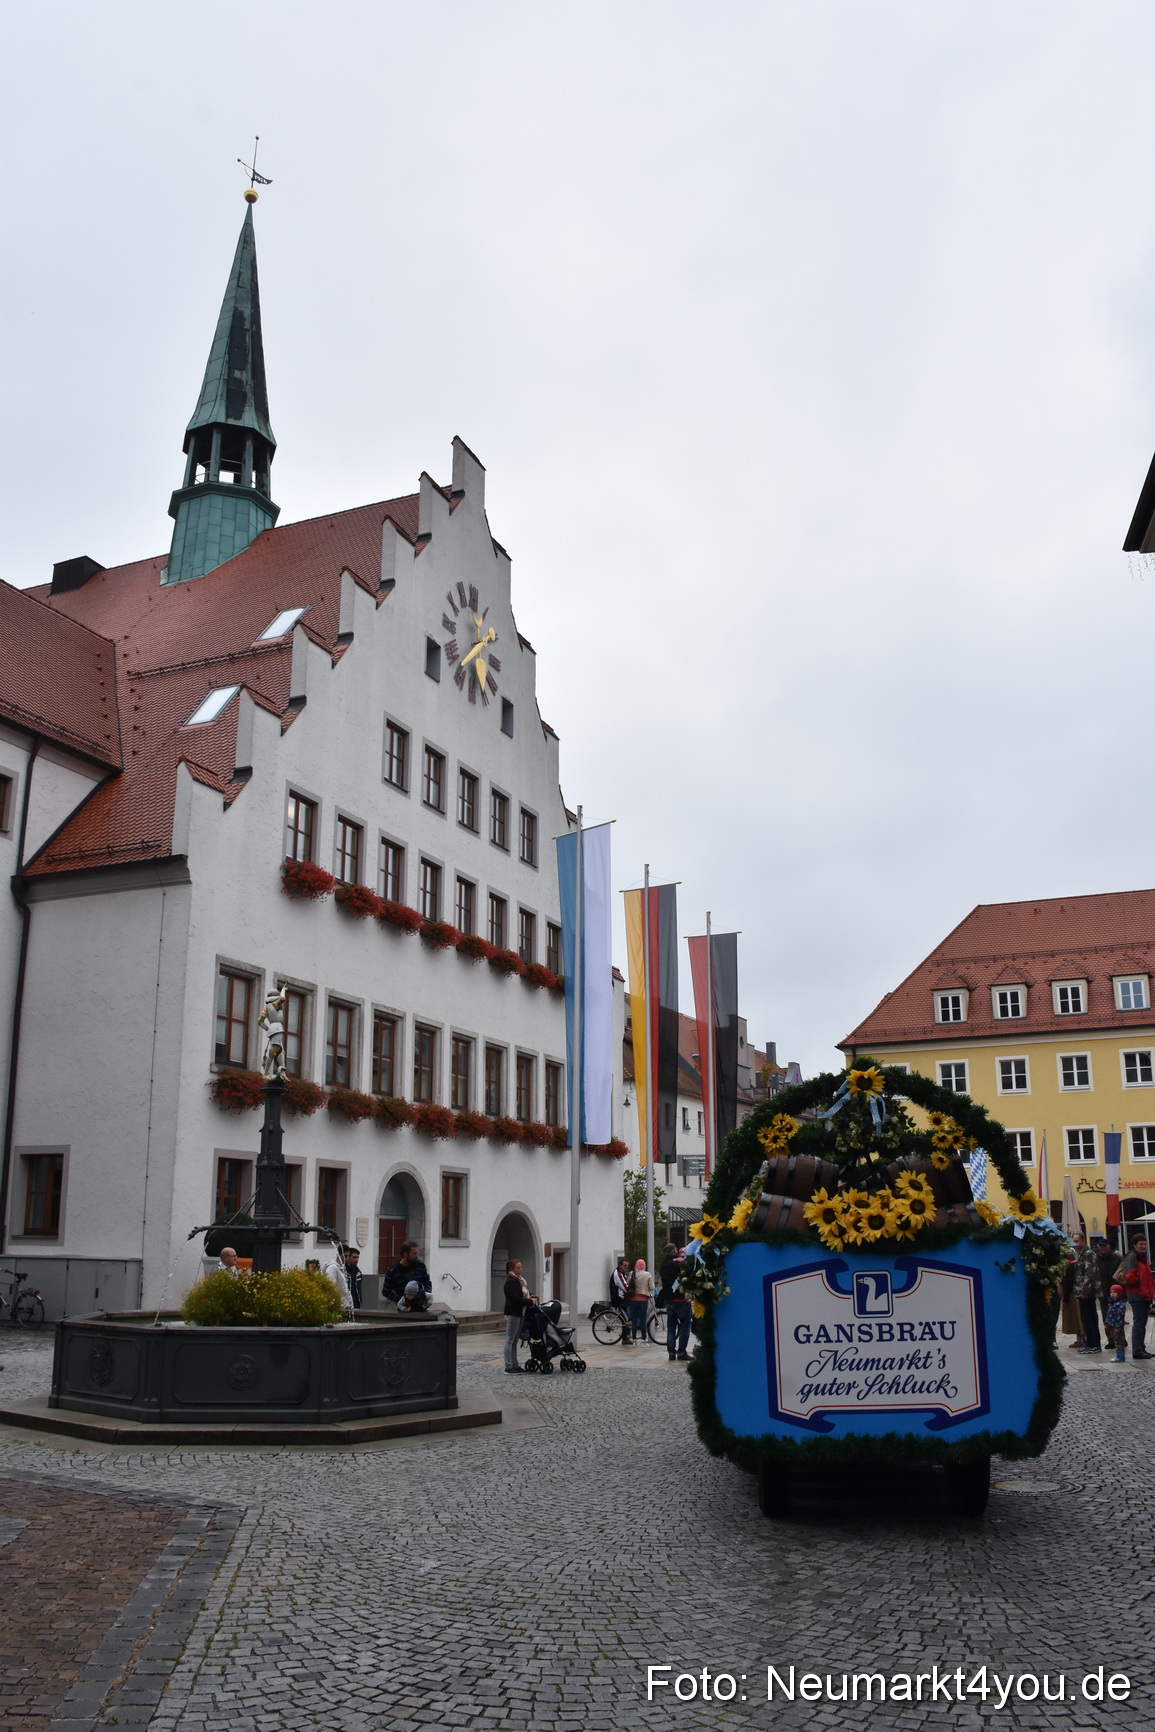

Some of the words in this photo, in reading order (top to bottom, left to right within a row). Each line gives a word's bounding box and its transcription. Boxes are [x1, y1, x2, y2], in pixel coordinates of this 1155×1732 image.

[793, 1321, 957, 1344] GANSBRÄU
[805, 1346, 947, 1378] Neumarkt's
[796, 1377, 859, 1404] guter
[856, 1373, 958, 1400] Schluck
